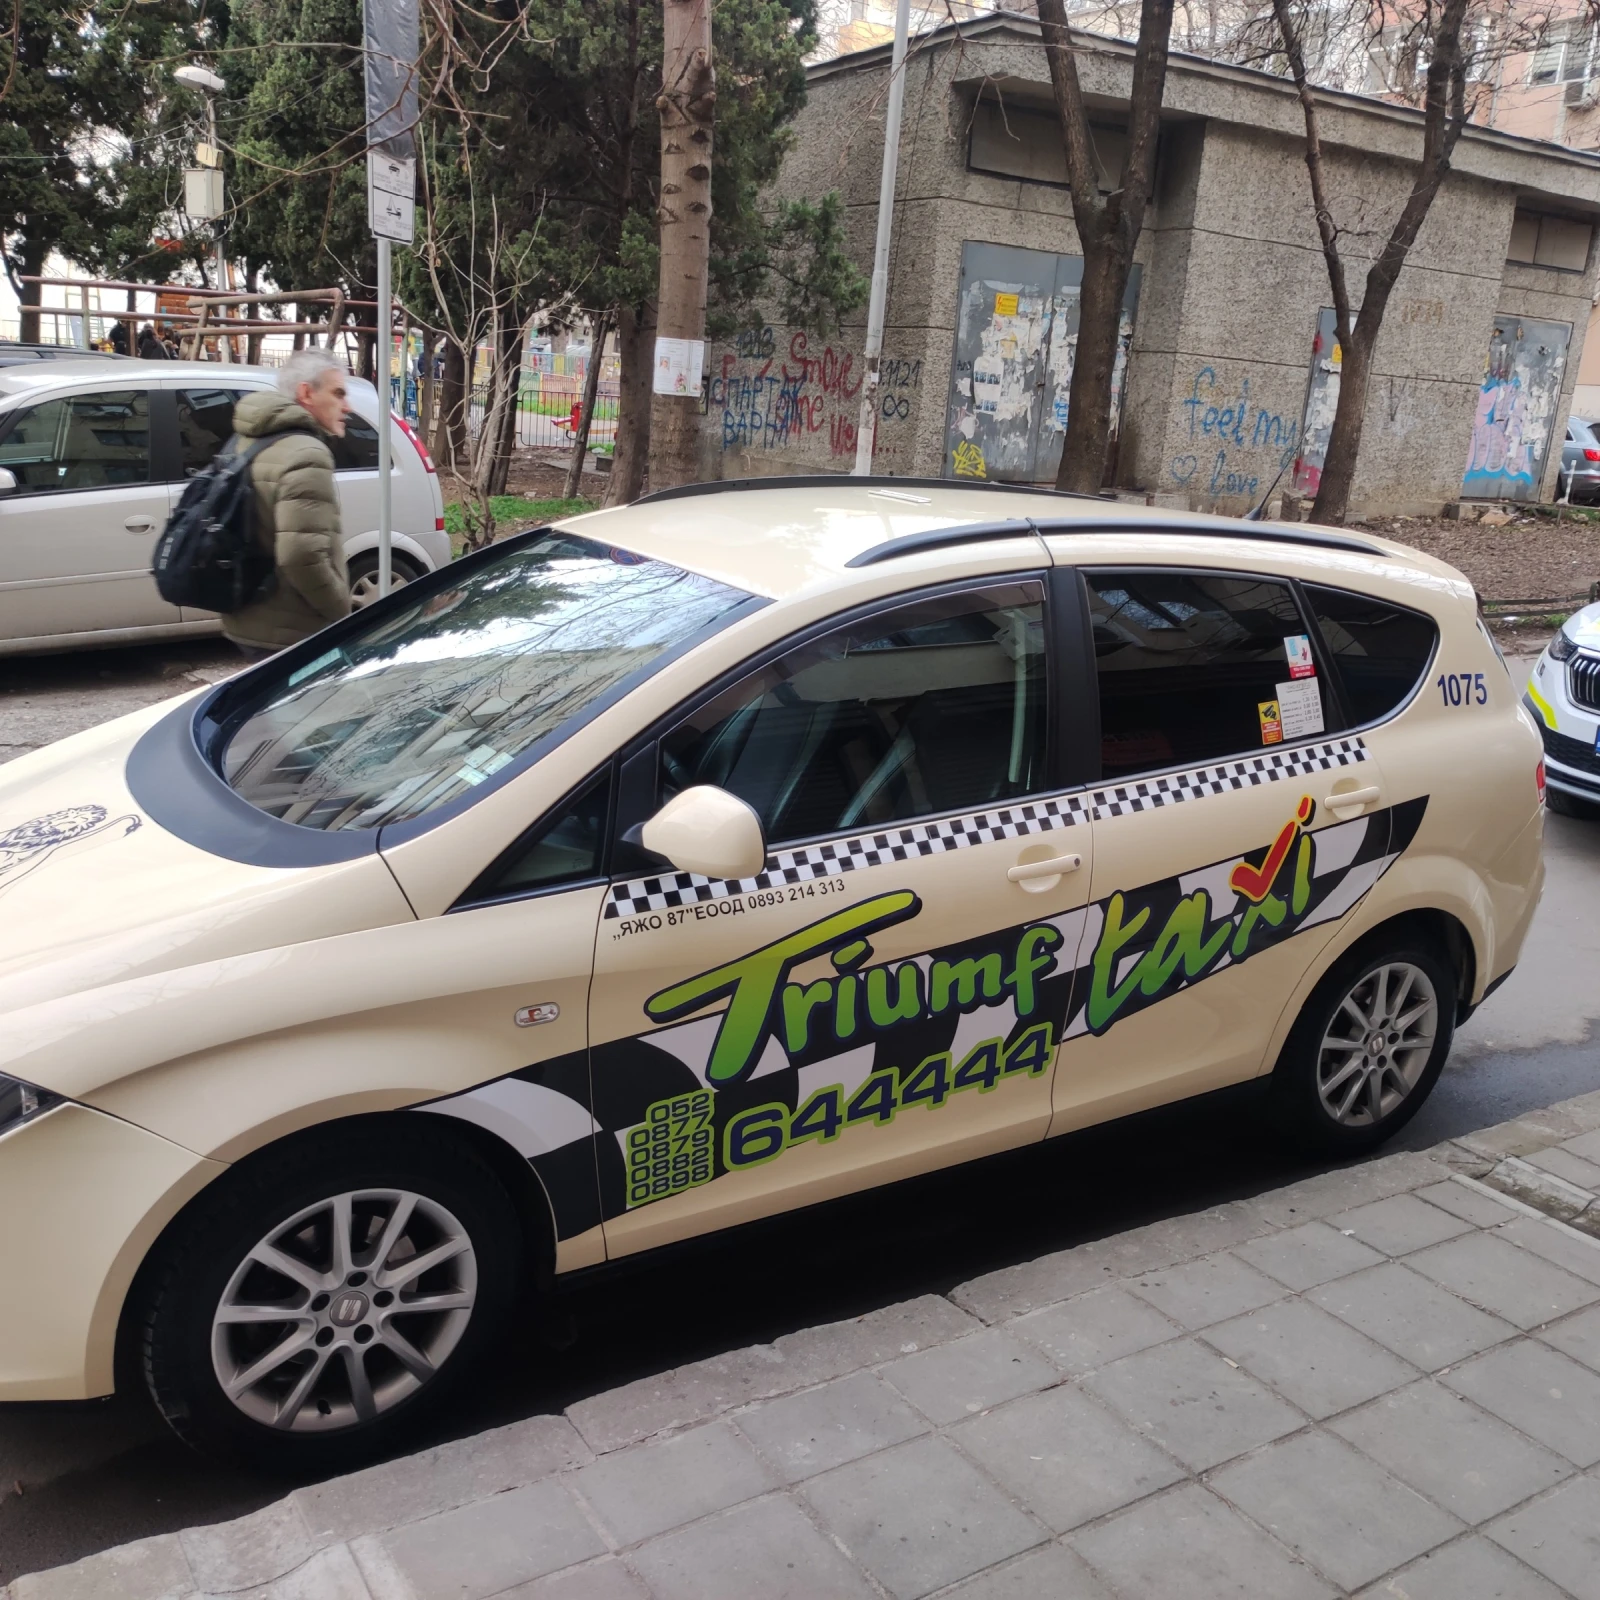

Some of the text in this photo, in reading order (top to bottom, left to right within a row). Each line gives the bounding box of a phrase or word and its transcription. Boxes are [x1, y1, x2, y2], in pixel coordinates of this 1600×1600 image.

[1437, 673, 1487, 707] 1075
[748, 890, 785, 909] 0893
[788, 884, 815, 902] 214
[819, 877, 846, 895] 313
[643, 795, 1316, 1085] Triumf taxi
[650, 1092, 710, 1124] 052
[727, 1028, 1052, 1166] 644444
[630, 1110, 710, 1148] 0877
[630, 1129, 710, 1166] 0879
[630, 1146, 710, 1184] 0882
[630, 1164, 710, 1202] 0898
